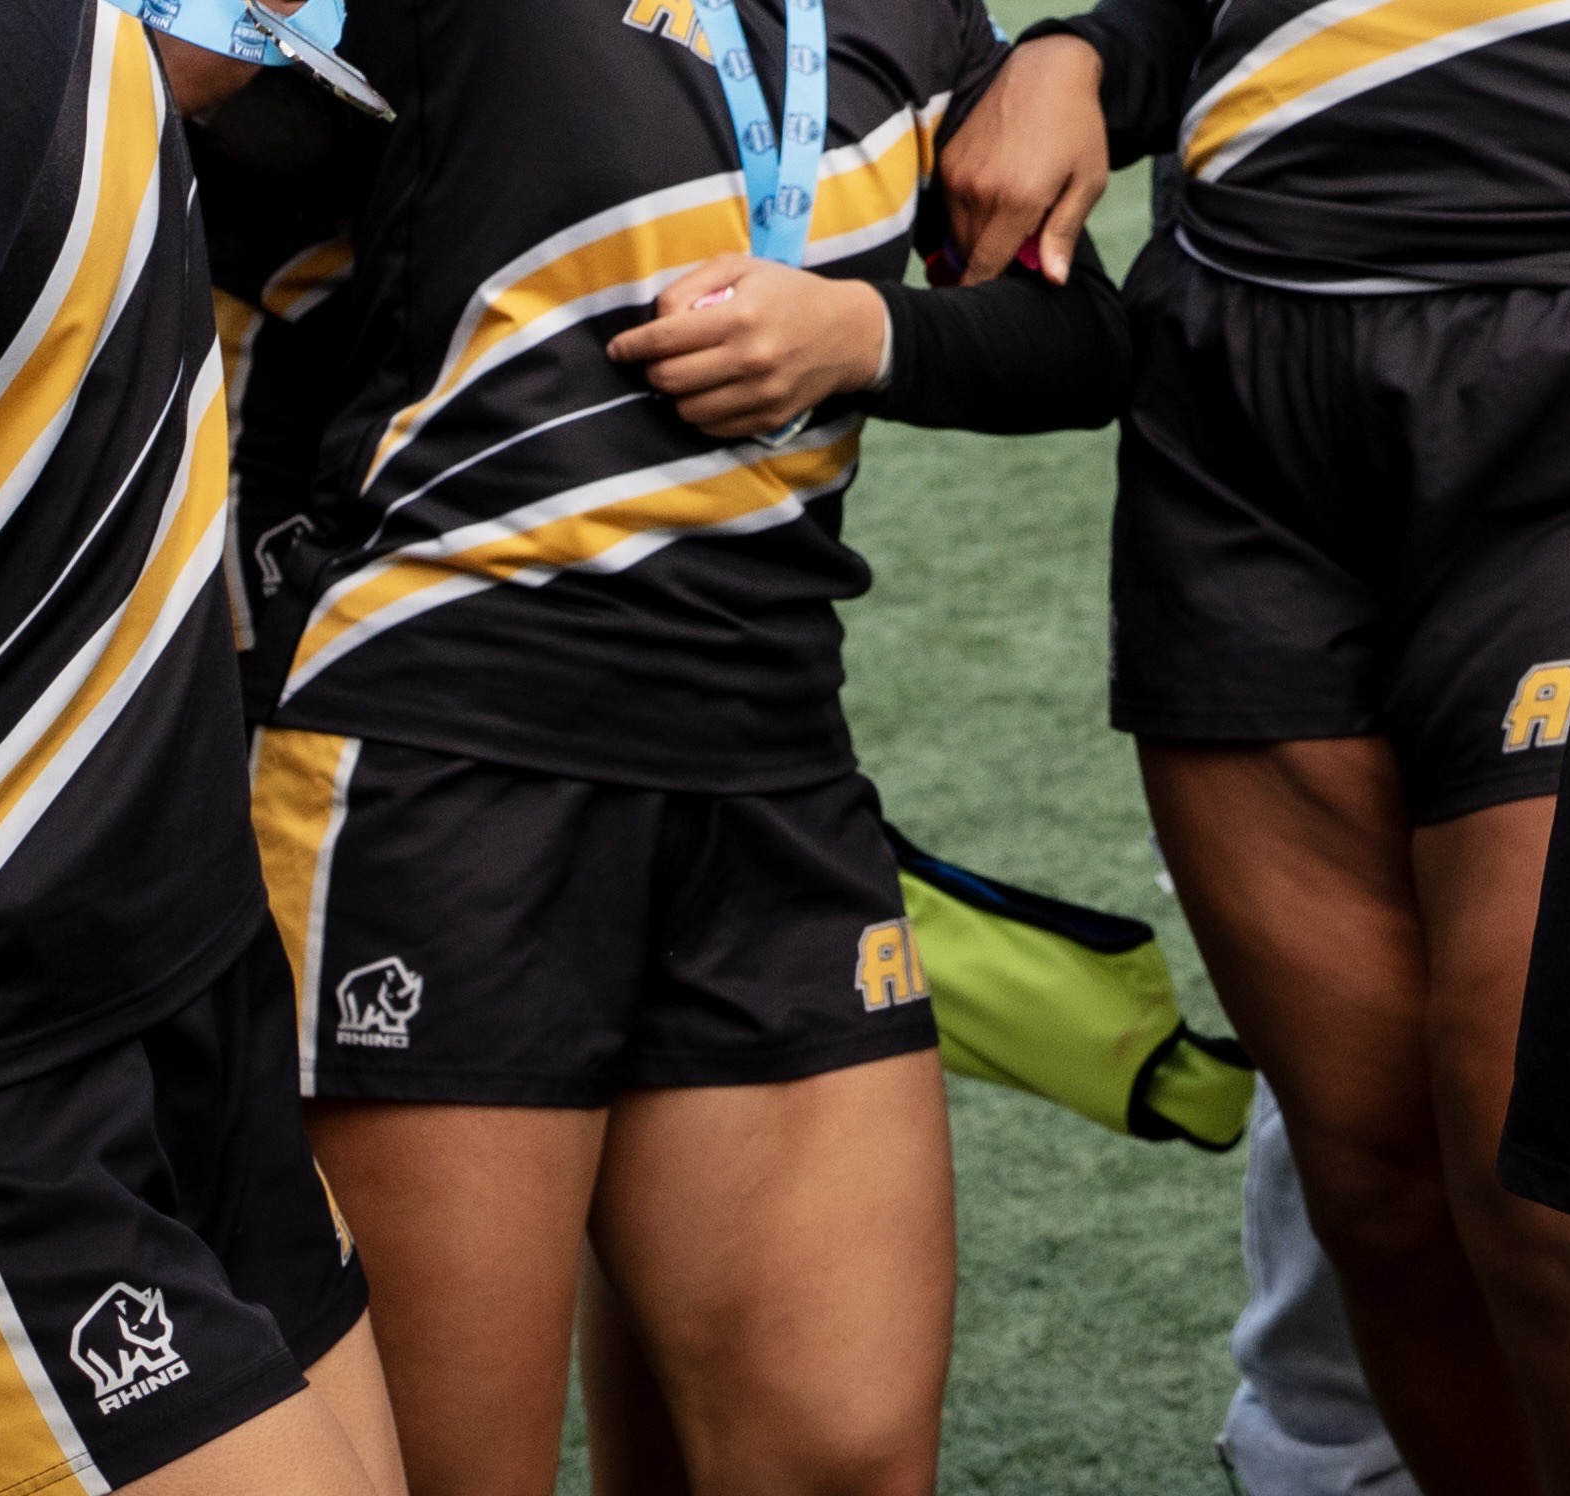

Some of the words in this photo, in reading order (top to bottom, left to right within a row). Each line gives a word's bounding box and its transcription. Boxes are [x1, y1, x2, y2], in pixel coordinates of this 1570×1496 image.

[142, 10, 172, 30] NIRA
[336, 1030, 409, 1048] RHINO
[98, 1359, 190, 1416] RHINO
